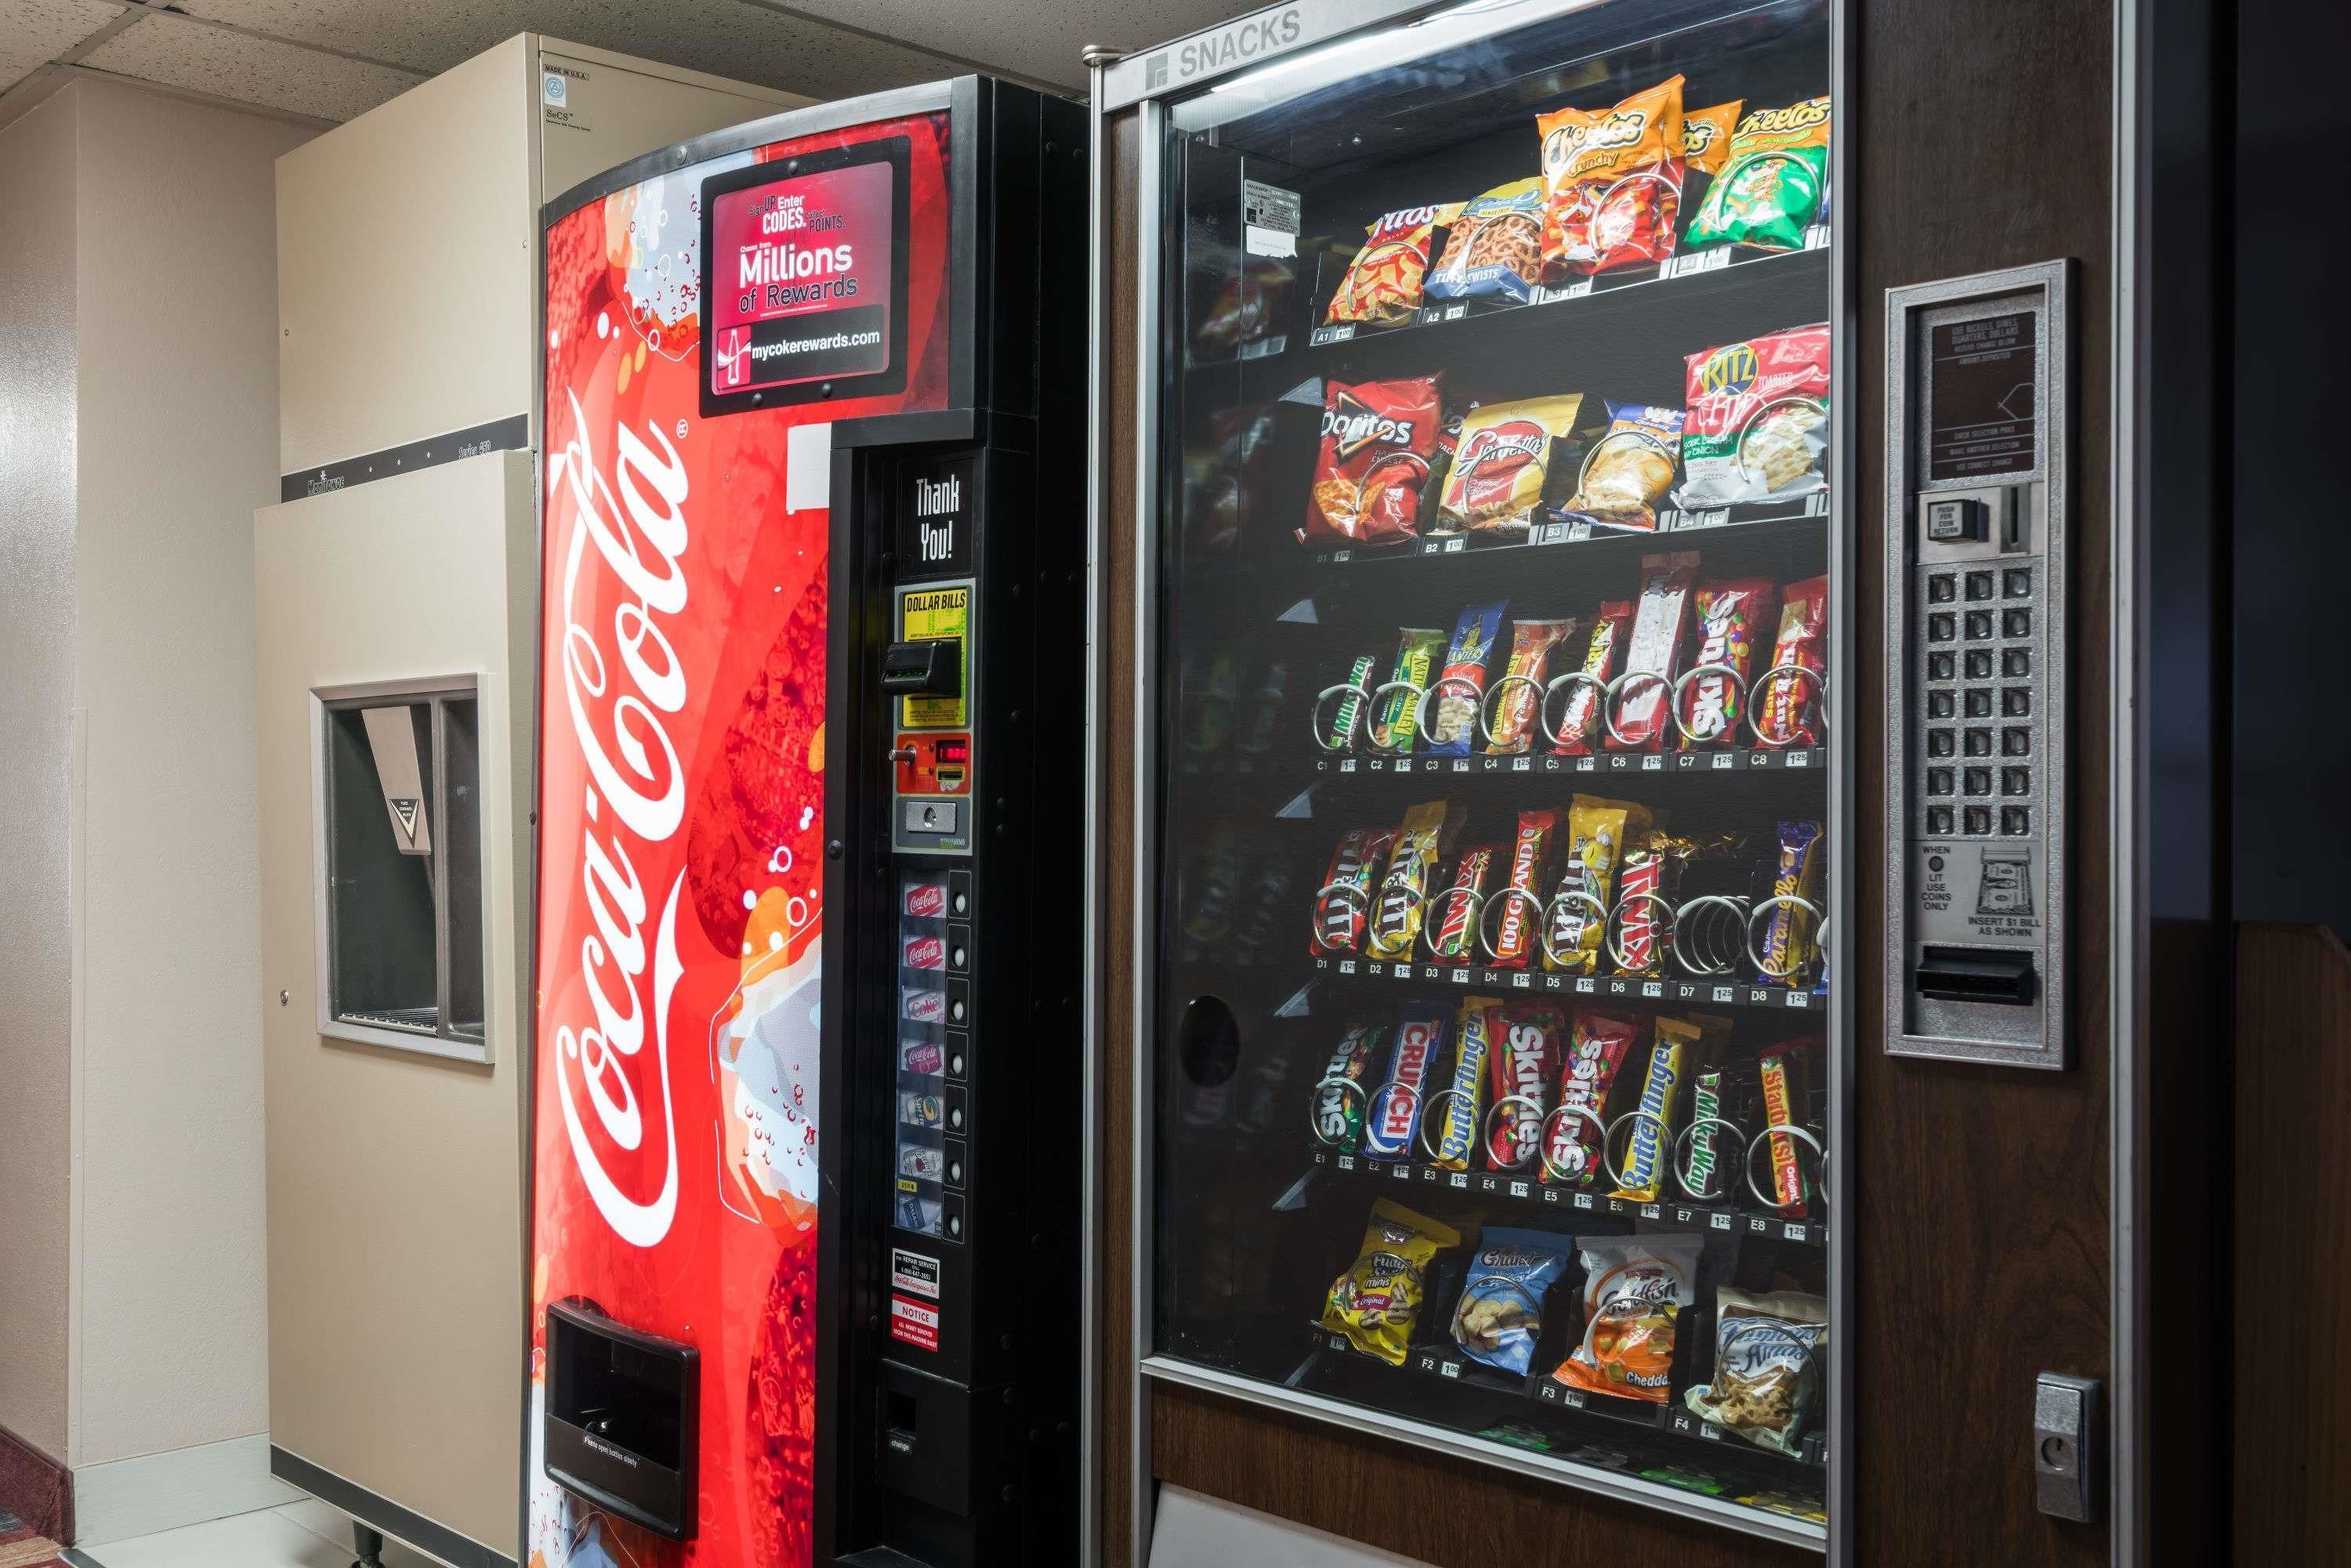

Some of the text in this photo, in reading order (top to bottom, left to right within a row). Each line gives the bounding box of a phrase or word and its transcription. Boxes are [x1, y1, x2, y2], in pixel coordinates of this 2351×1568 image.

[1179, 9, 1301, 78] SNACKS
[1730, 101, 1831, 144] heetos
[777, 195, 805, 210] Enter
[763, 206, 806, 234] CODES.
[740, 244, 853, 288] Millions
[740, 288, 757, 313] of
[767, 273, 858, 308] Rewards
[1426, 313, 1439, 323] A2
[1317, 333, 1328, 342] A1
[752, 331, 880, 360] mycokerewards.com
[1702, 349, 1755, 393] RITZ
[1320, 411, 1413, 444] Doritos
[916, 474, 960, 516] Thank
[1547, 527, 1560, 538] B3
[921, 520, 953, 561] You!
[1425, 543, 1438, 553] B2
[907, 592, 966, 613] DOLLAR BILLS
[1371, 761, 1382, 770] C2
[1426, 761, 1438, 770] C3
[1484, 759, 1498, 770] C4
[1546, 759, 1559, 770] C5
[1611, 757, 1626, 767] C6
[1679, 756, 1694, 766] C7
[1751, 755, 1766, 765] C8
[549, 386, 689, 1248] Coca-Cola
[1922, 893, 1951, 901] COINS
[1924, 902, 1949, 911] ONLY
[1969, 917, 2041, 927] INSERT $1 BILL
[1502, 916, 1520, 950] 100
[1995, 928, 2032, 936] SHOWN
[1317, 960, 1328, 969] D1
[1370, 965, 1382, 974] D2
[1426, 969, 1438, 977] D3
[1485, 972, 1498, 982] D4
[1546, 978, 1560, 987] D5
[1611, 983, 1625, 992] D6
[1680, 987, 1695, 997] D7
[1751, 991, 1766, 1001] D8
[1386, 1023, 1429, 1135] CRUNCH
[1316, 1154, 1325, 1164] E1
[1425, 1171, 1436, 1180] E3
[1483, 1179, 1495, 1190] E4
[1545, 1191, 1557, 1201] E5
[1678, 1211, 1692, 1221] E7
[1751, 1219, 1766, 1231] E8
[903, 1255, 918, 1265] REPAIR
[918, 1261, 936, 1270] SERVICE
[903, 1306, 929, 1323] NOTICE
[1422, 1358, 1434, 1369] F2
[1625, 1371, 1672, 1387] Chedda
[1542, 1386, 1555, 1398] F3
[1675, 1417, 1689, 1430] F4
[891, 1439, 909, 1451] change
